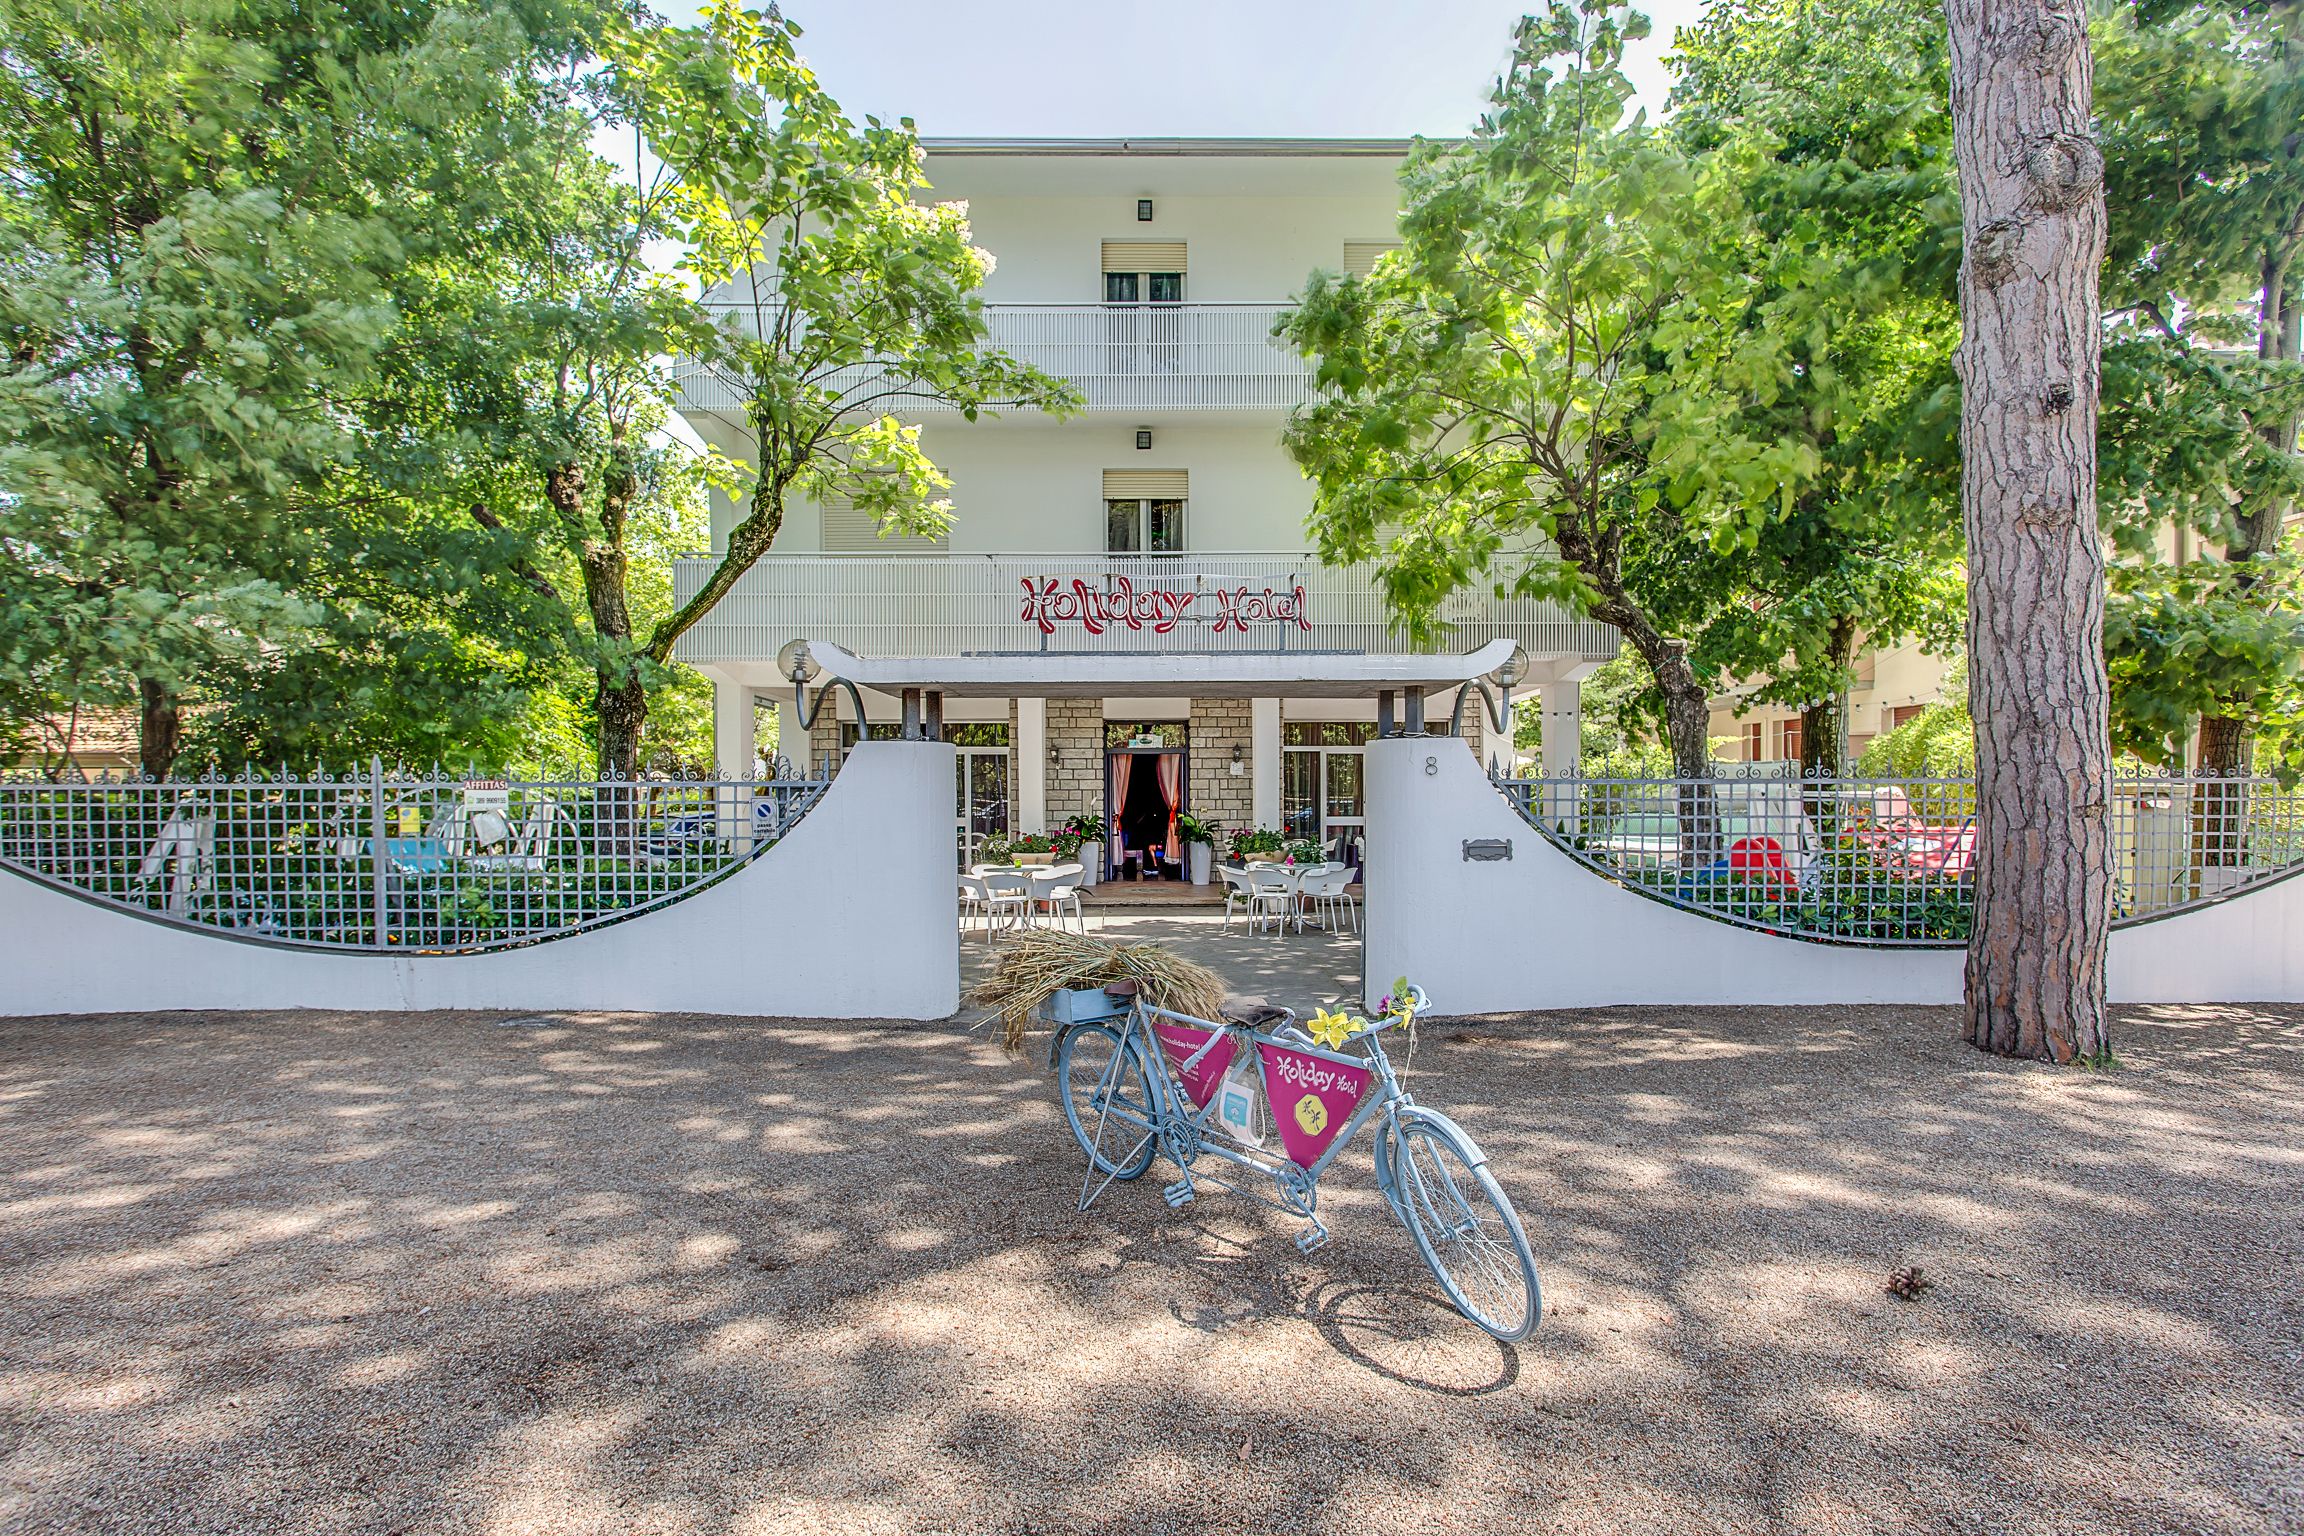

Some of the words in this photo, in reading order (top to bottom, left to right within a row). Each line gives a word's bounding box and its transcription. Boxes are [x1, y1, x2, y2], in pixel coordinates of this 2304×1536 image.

[1021, 577, 1194, 634] Holiday
[1213, 585, 1312, 633] Hotel
[1425, 756, 1438, 775] 8
[464, 781, 508, 790] AFFITTASI
[1276, 1055, 1335, 1092] Holiday
[1336, 1074, 1358, 1098] Hotel
